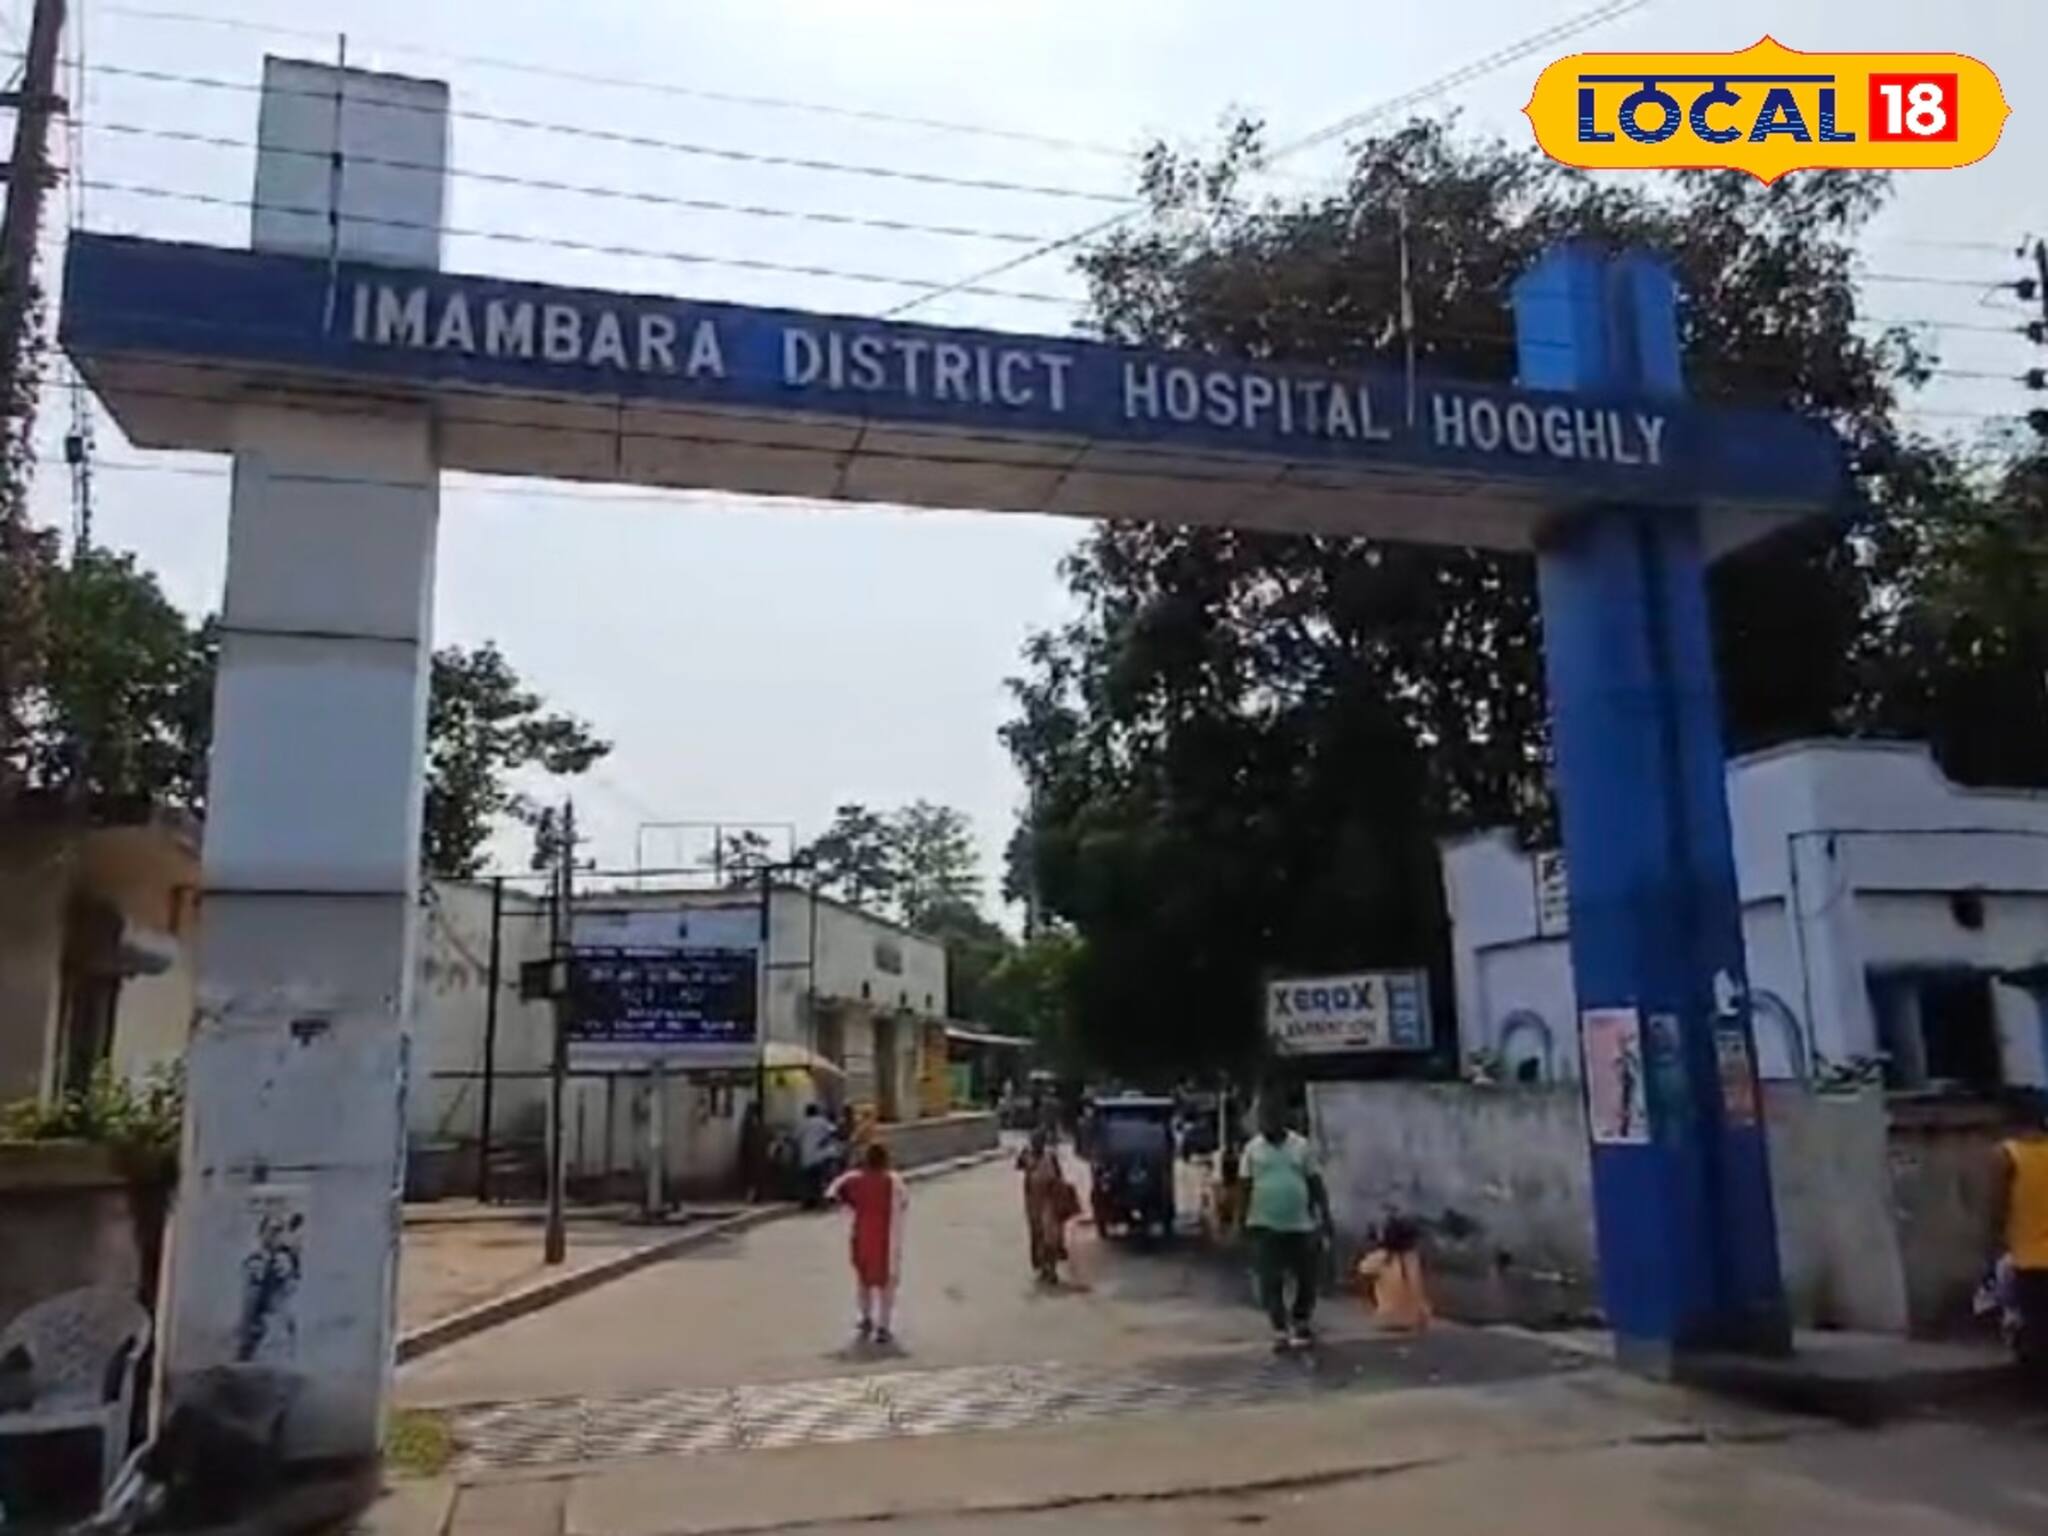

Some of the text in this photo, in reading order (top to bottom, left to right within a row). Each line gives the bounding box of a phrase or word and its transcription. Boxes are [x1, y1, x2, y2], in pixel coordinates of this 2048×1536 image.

[353, 284, 1665, 466] IMAMBARA DISTRICT HOSPITAL HOOGHLY
